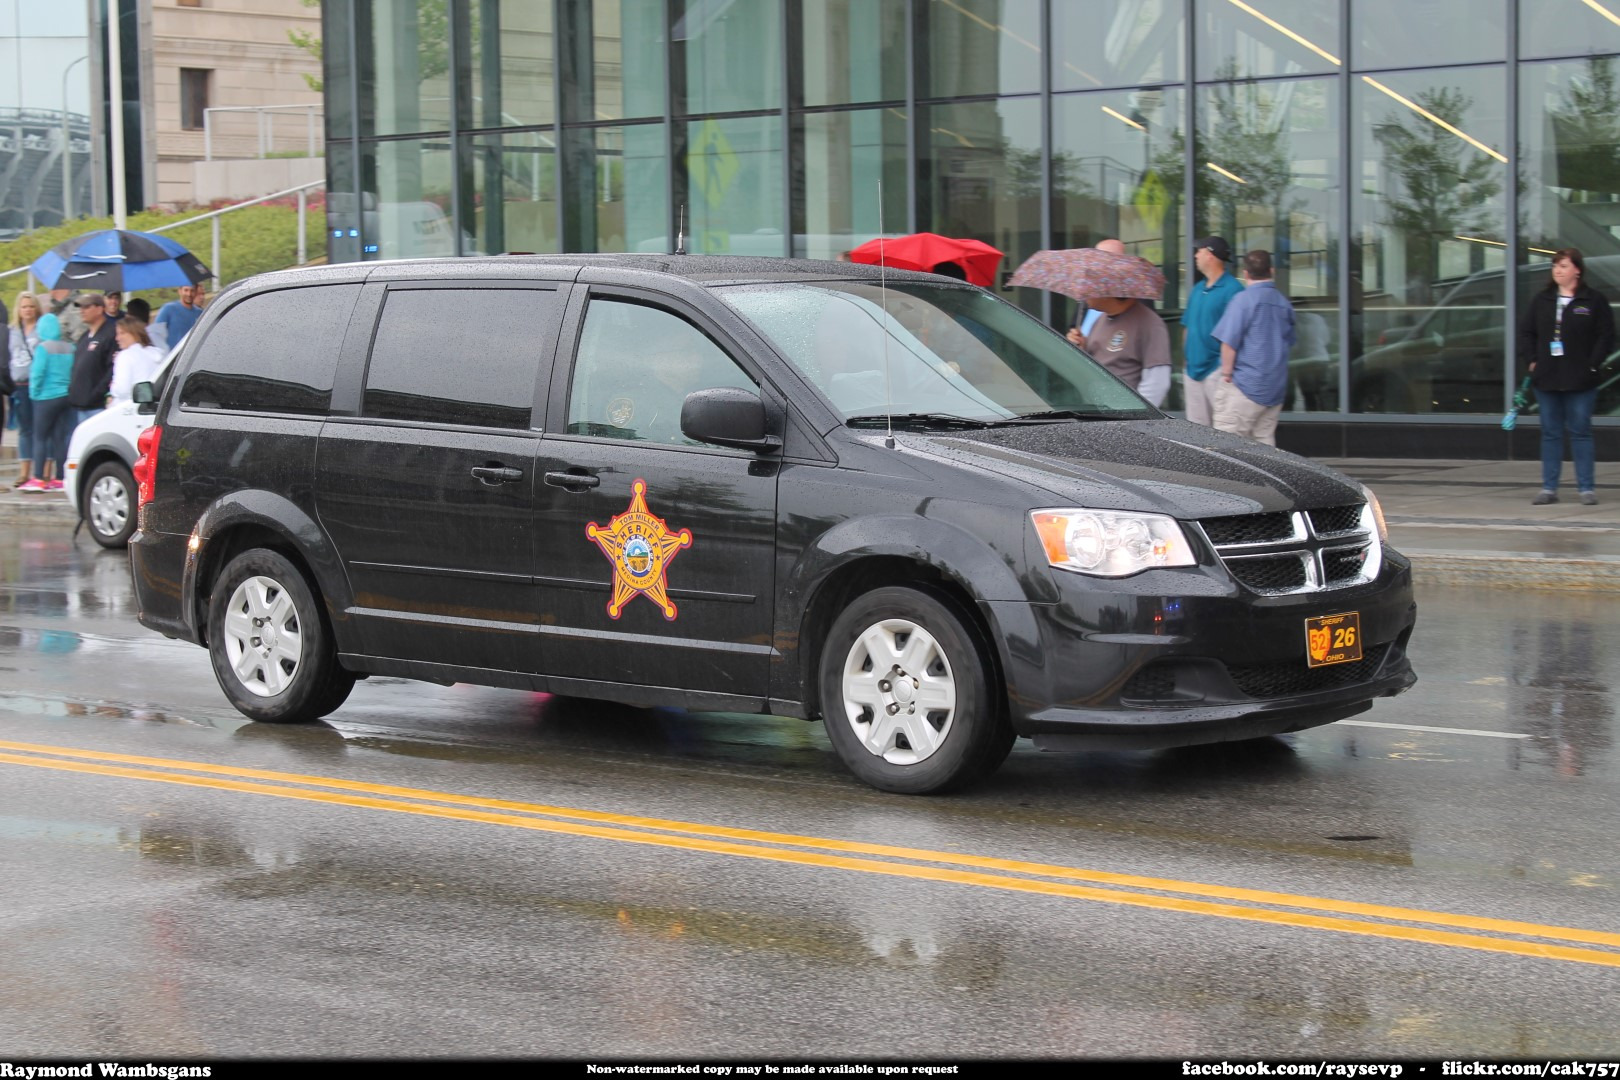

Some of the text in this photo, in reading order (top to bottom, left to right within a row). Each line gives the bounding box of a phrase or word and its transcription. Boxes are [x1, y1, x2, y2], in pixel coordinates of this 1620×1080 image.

[620, 514, 659, 531] TOM MILLER
[616, 525, 658, 549] SHERIFF
[639, 569, 657, 585] COUNTY
[1321, 617, 1344, 625] SHERIFF
[1311, 627, 1355, 651] 52 26
[1326, 653, 1344, 661] OHIO
